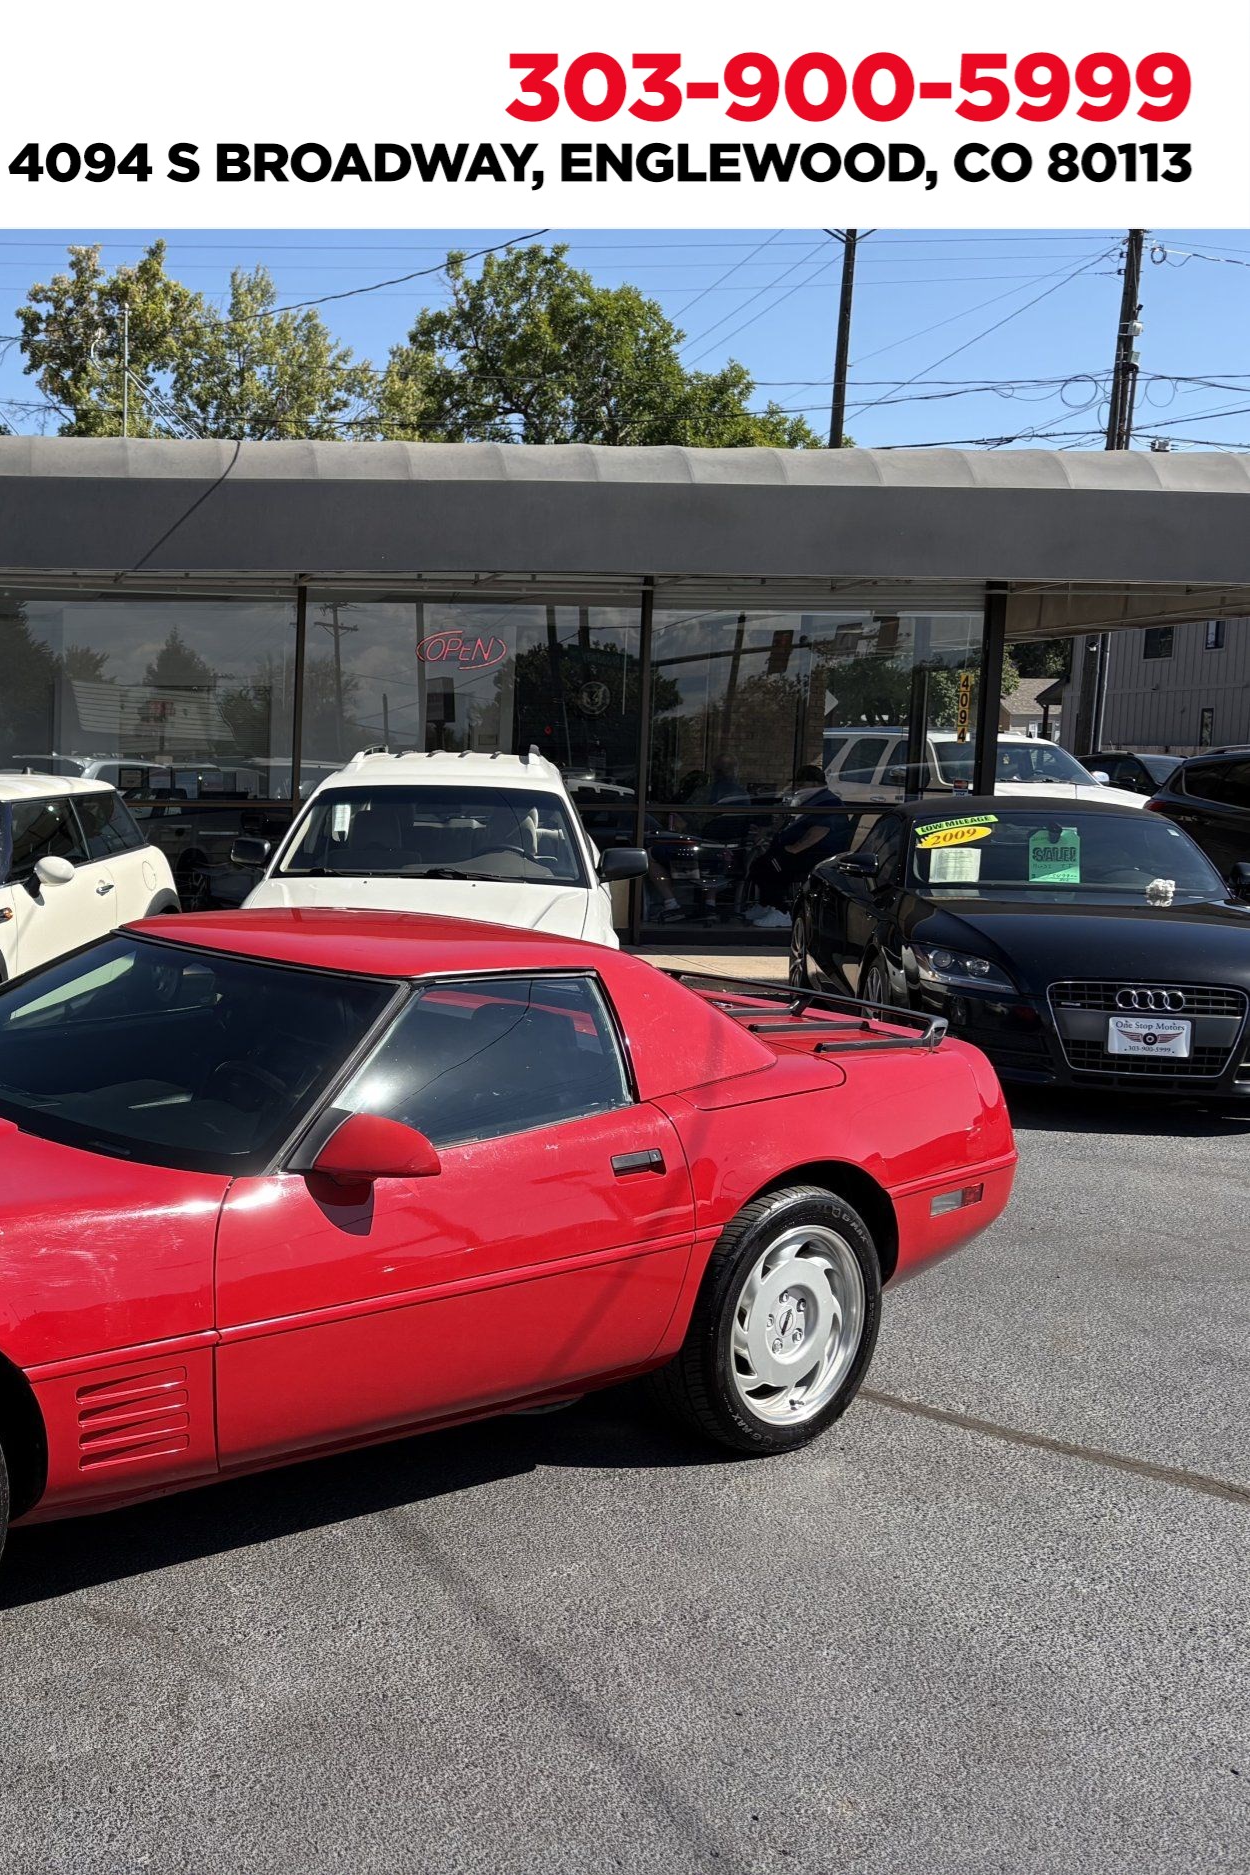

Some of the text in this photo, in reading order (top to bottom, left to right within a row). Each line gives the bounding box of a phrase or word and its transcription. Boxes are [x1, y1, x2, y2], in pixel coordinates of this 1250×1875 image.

[426, 637, 495, 661] OPEN
[958, 675, 969, 743] 4094
[920, 816, 990, 833] LOW MILEAGE
[931, 828, 977, 846] 2009
[1032, 846, 1077, 862] SALE!
[1115, 1020, 1185, 1031] One Stop Motors
